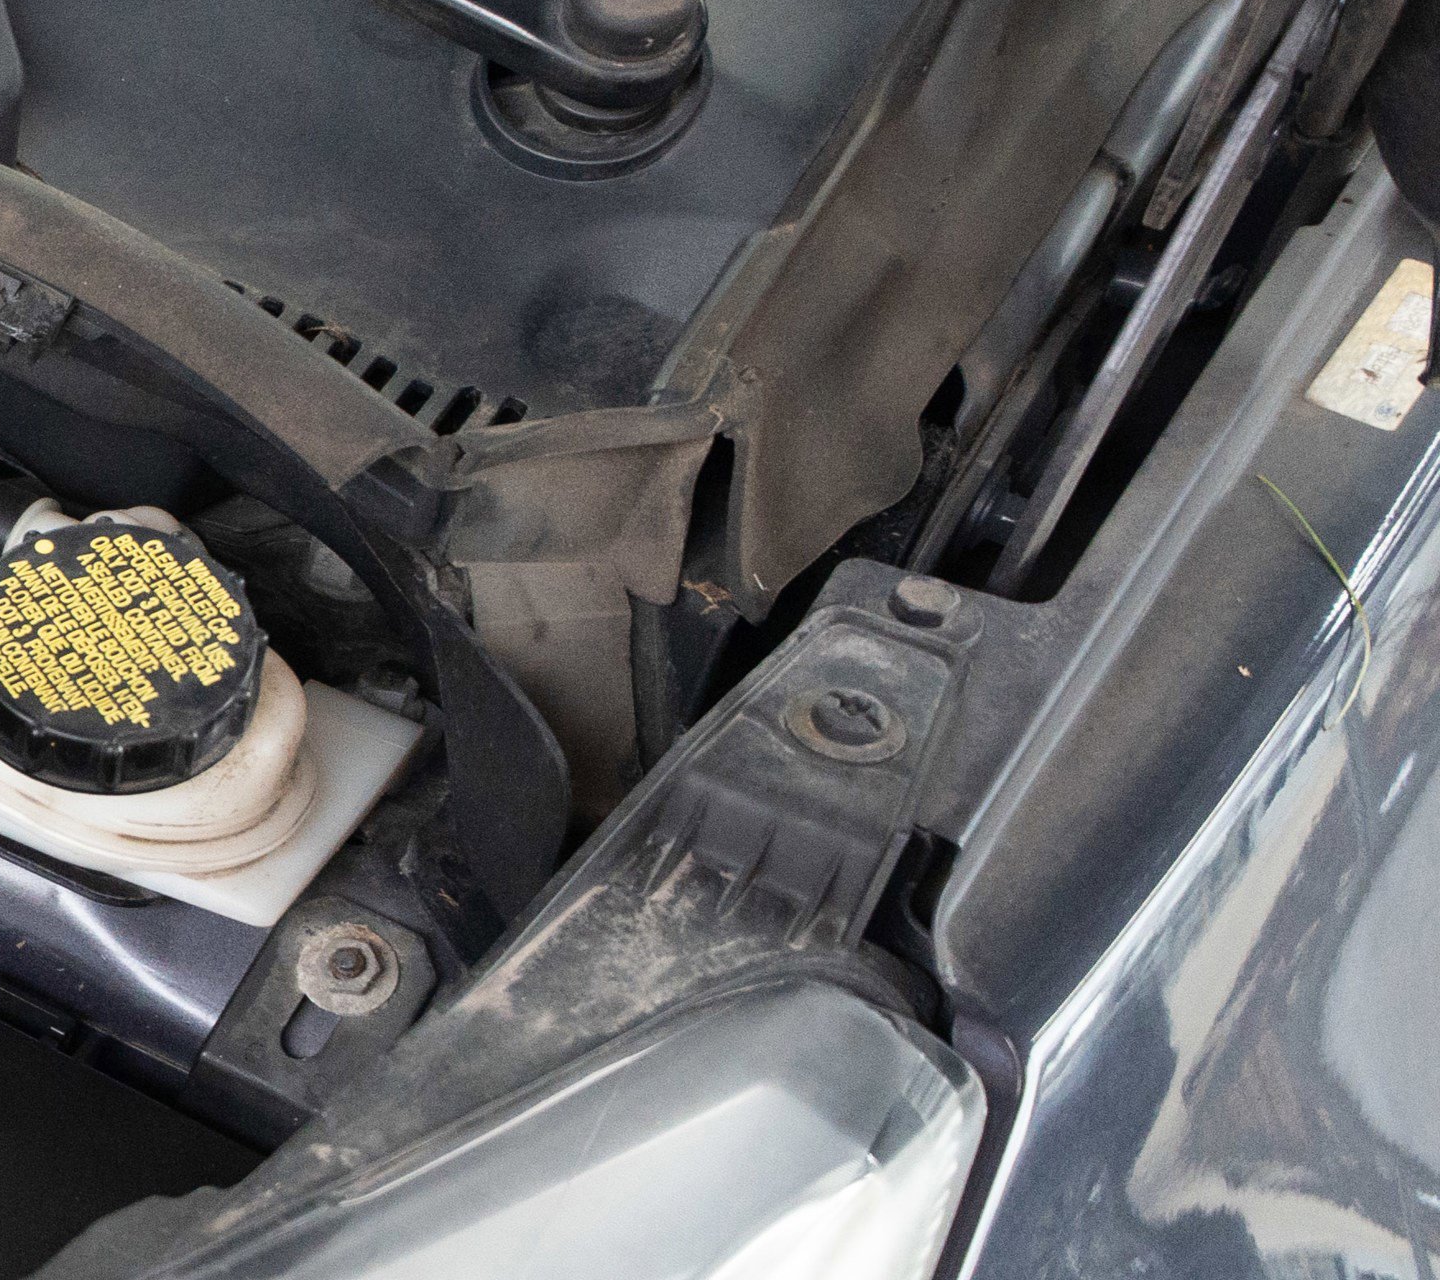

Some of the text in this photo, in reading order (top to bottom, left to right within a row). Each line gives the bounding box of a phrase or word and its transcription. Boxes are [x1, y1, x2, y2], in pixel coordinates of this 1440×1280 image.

[9, 560, 150, 728] AVANT DE LE DÉPOSER. N'EM-
[12, 624, 32, 638] 3
[37, 561, 159, 702] NETTOYER LE BOUCHON
[72, 576, 160, 673] AVERTISSEMENT:
[78, 553, 189, 682] A SEALED CONTAINER.
[90, 536, 221, 686] ONLY DOT 3 FLUID FROM
[113, 534, 236, 672] BEFORE REMOVING. USE
[142, 539, 240, 644] CLEAN FILLER CAP
[184, 557, 242, 619] WARNING:
[0, 576, 126, 724] PLOYER QUE DU LIQUIDE
[0, 641, 69, 713] CONTENANT
[21, 638, 91, 711] PROVENANT
